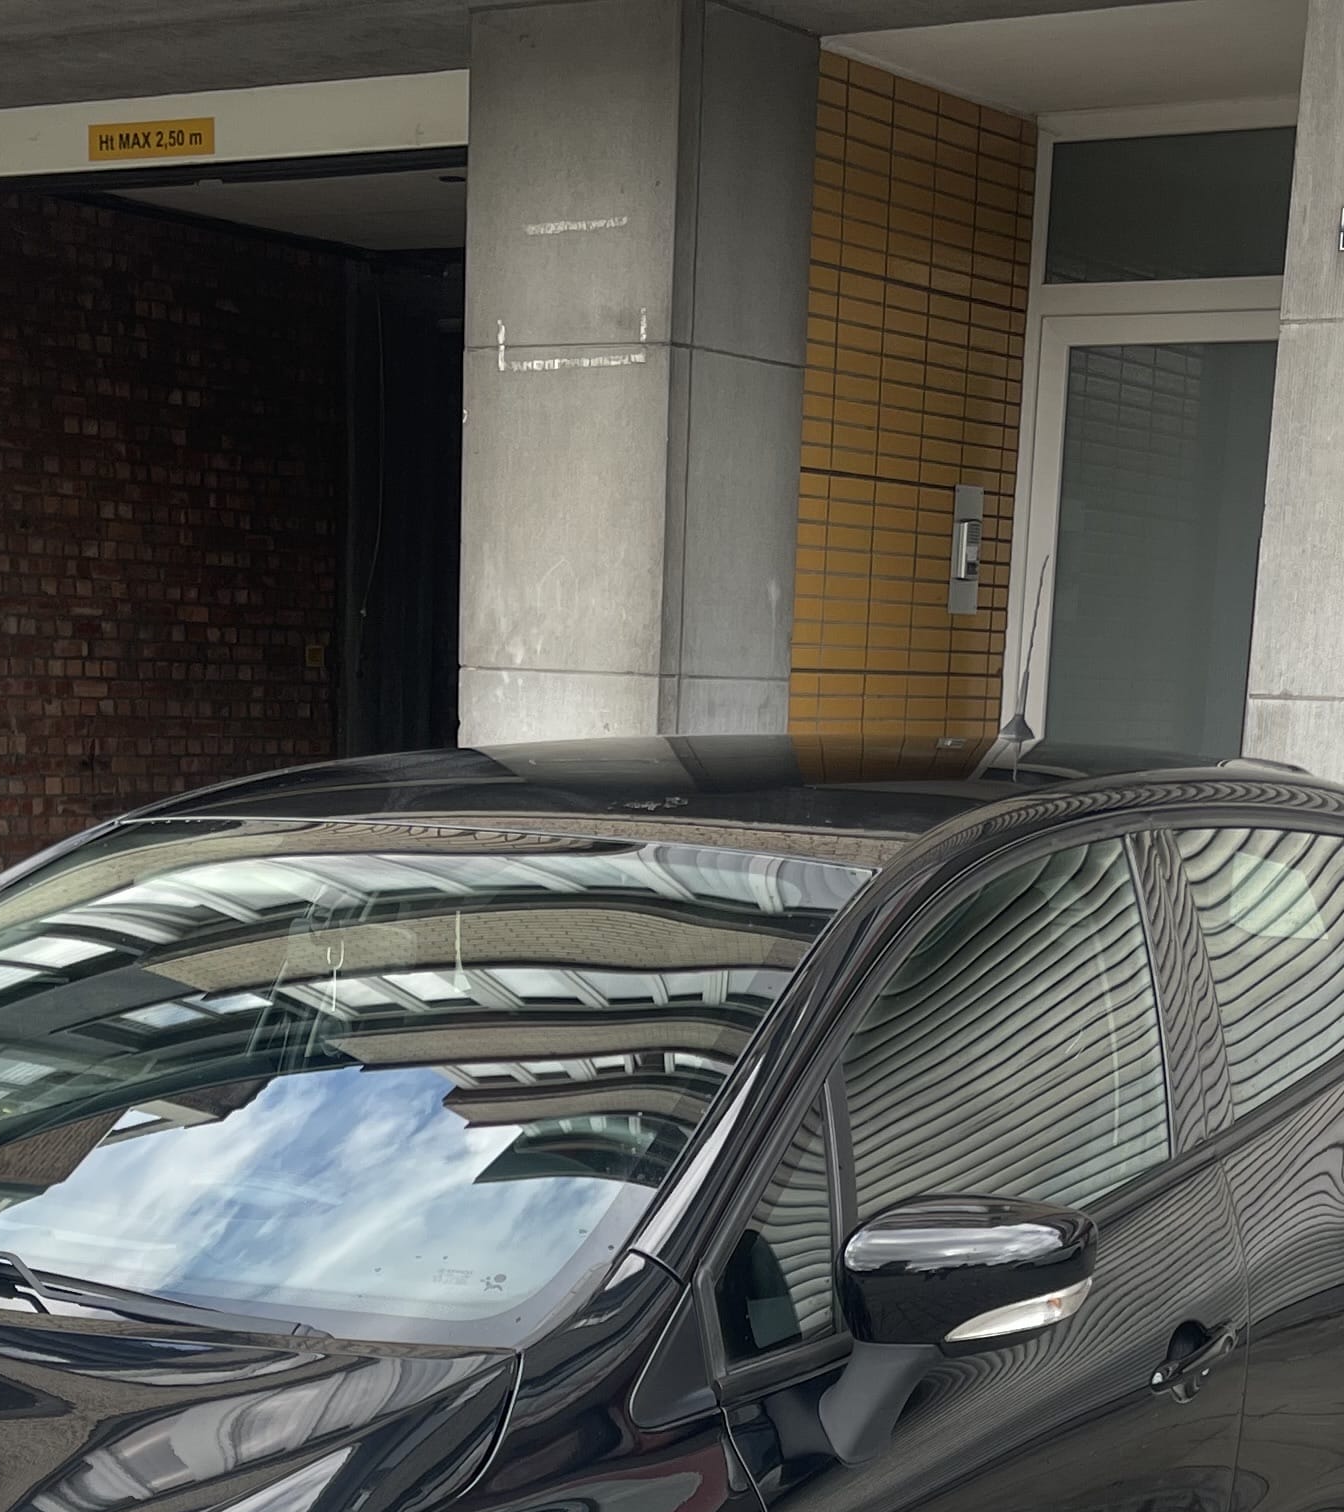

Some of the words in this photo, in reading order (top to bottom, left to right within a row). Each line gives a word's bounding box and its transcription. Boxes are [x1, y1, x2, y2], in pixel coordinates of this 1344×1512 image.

[99, 134, 115, 151] Ht
[118, 131, 152, 150] MAX
[155, 129, 185, 150] 2,50
[189, 131, 203, 146] m
